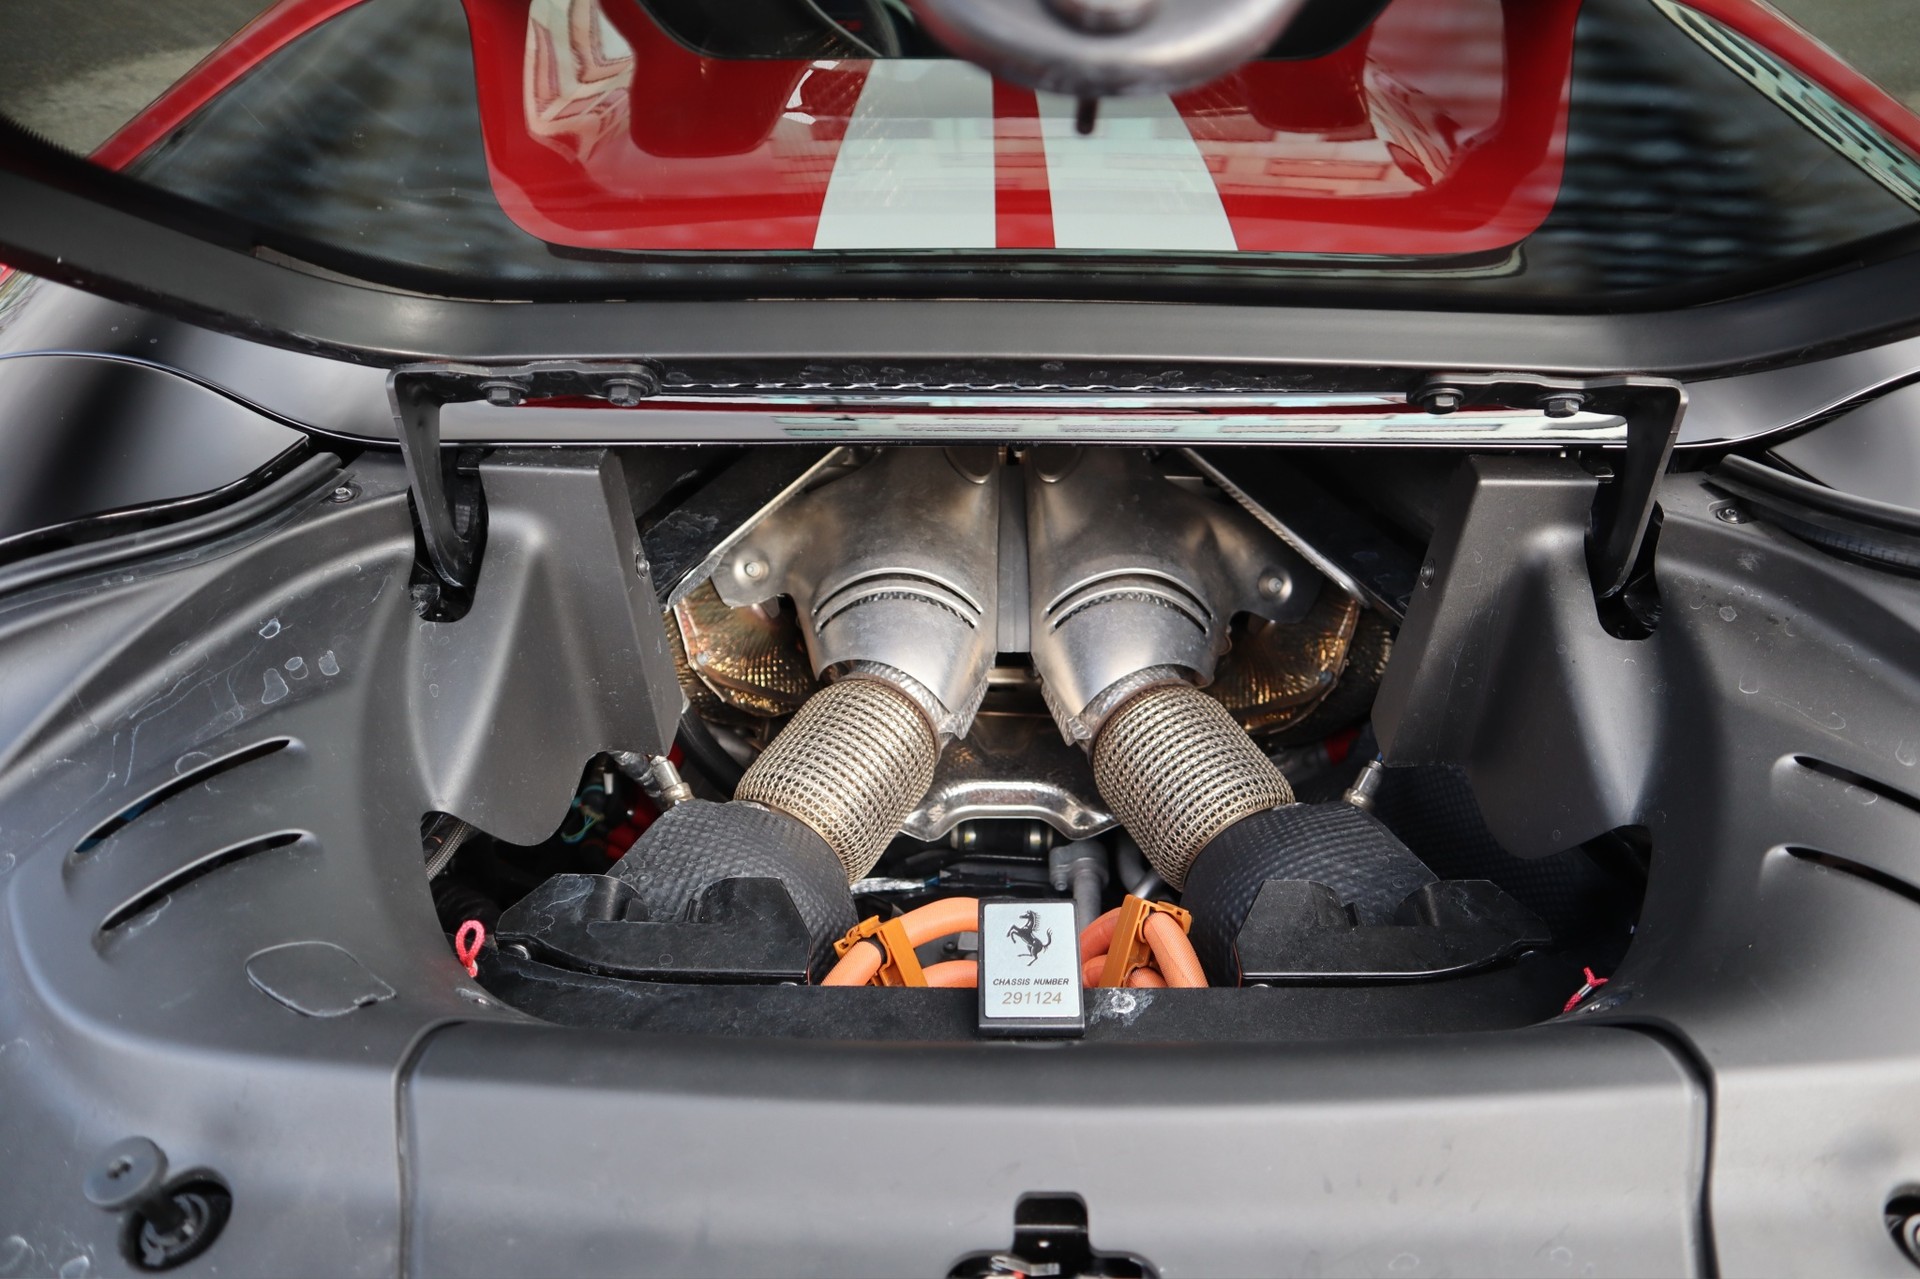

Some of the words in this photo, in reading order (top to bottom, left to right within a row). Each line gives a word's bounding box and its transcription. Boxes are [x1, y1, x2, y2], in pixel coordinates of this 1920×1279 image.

[992, 978, 1030, 986] CHASSIS
[1033, 978, 1069, 986] NUMBER
[1002, 991, 1062, 1004] 291124
